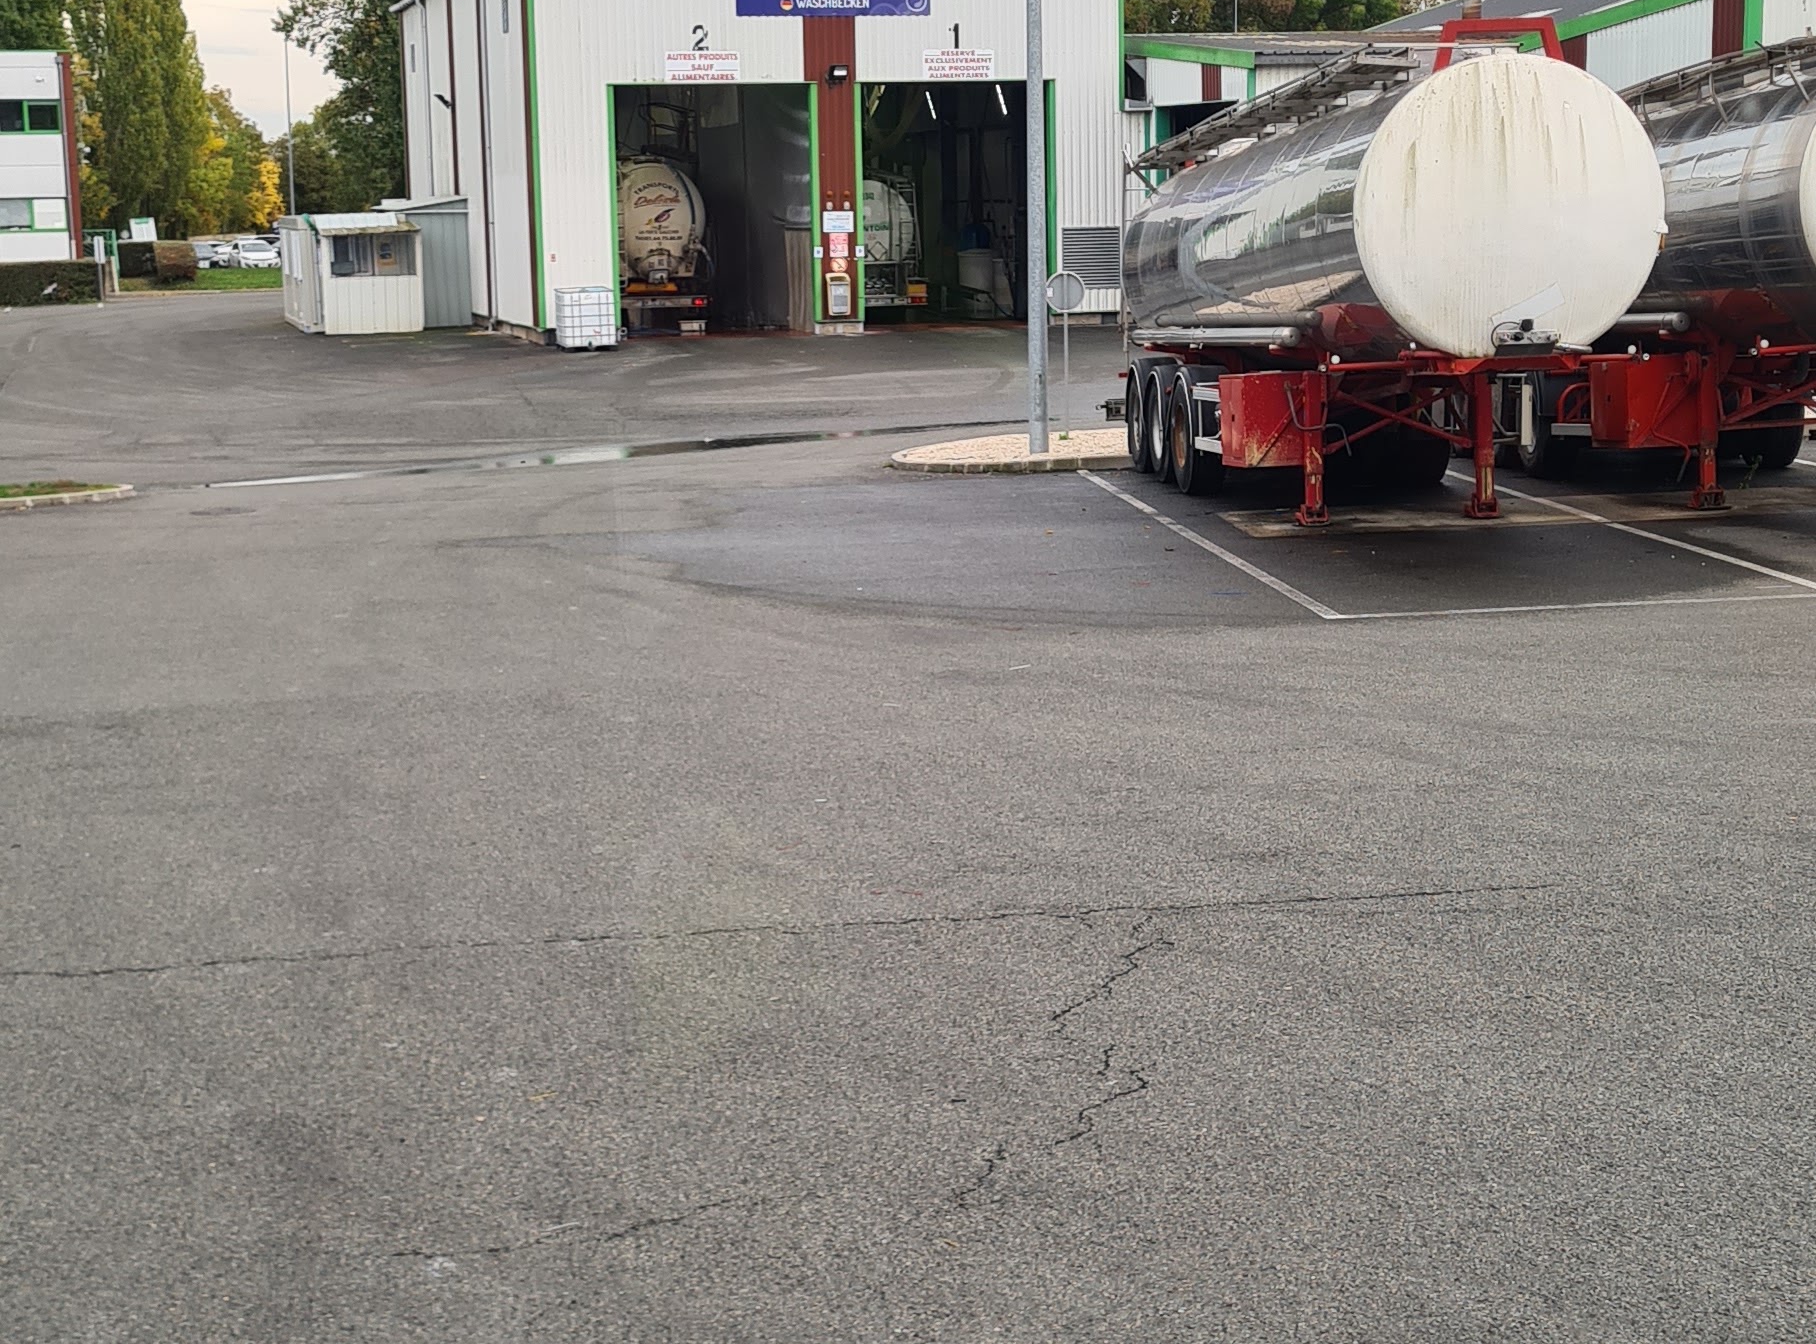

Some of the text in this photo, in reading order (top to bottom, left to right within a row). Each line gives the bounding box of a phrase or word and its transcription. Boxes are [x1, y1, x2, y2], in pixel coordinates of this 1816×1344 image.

[692, 24, 710, 52] 2
[948, 23, 960, 49] 1
[666, 53, 739, 61] AUTRES PRODUITS
[691, 63, 715, 72] SAUF
[671, 73, 736, 81] ALIMENTAIRES
